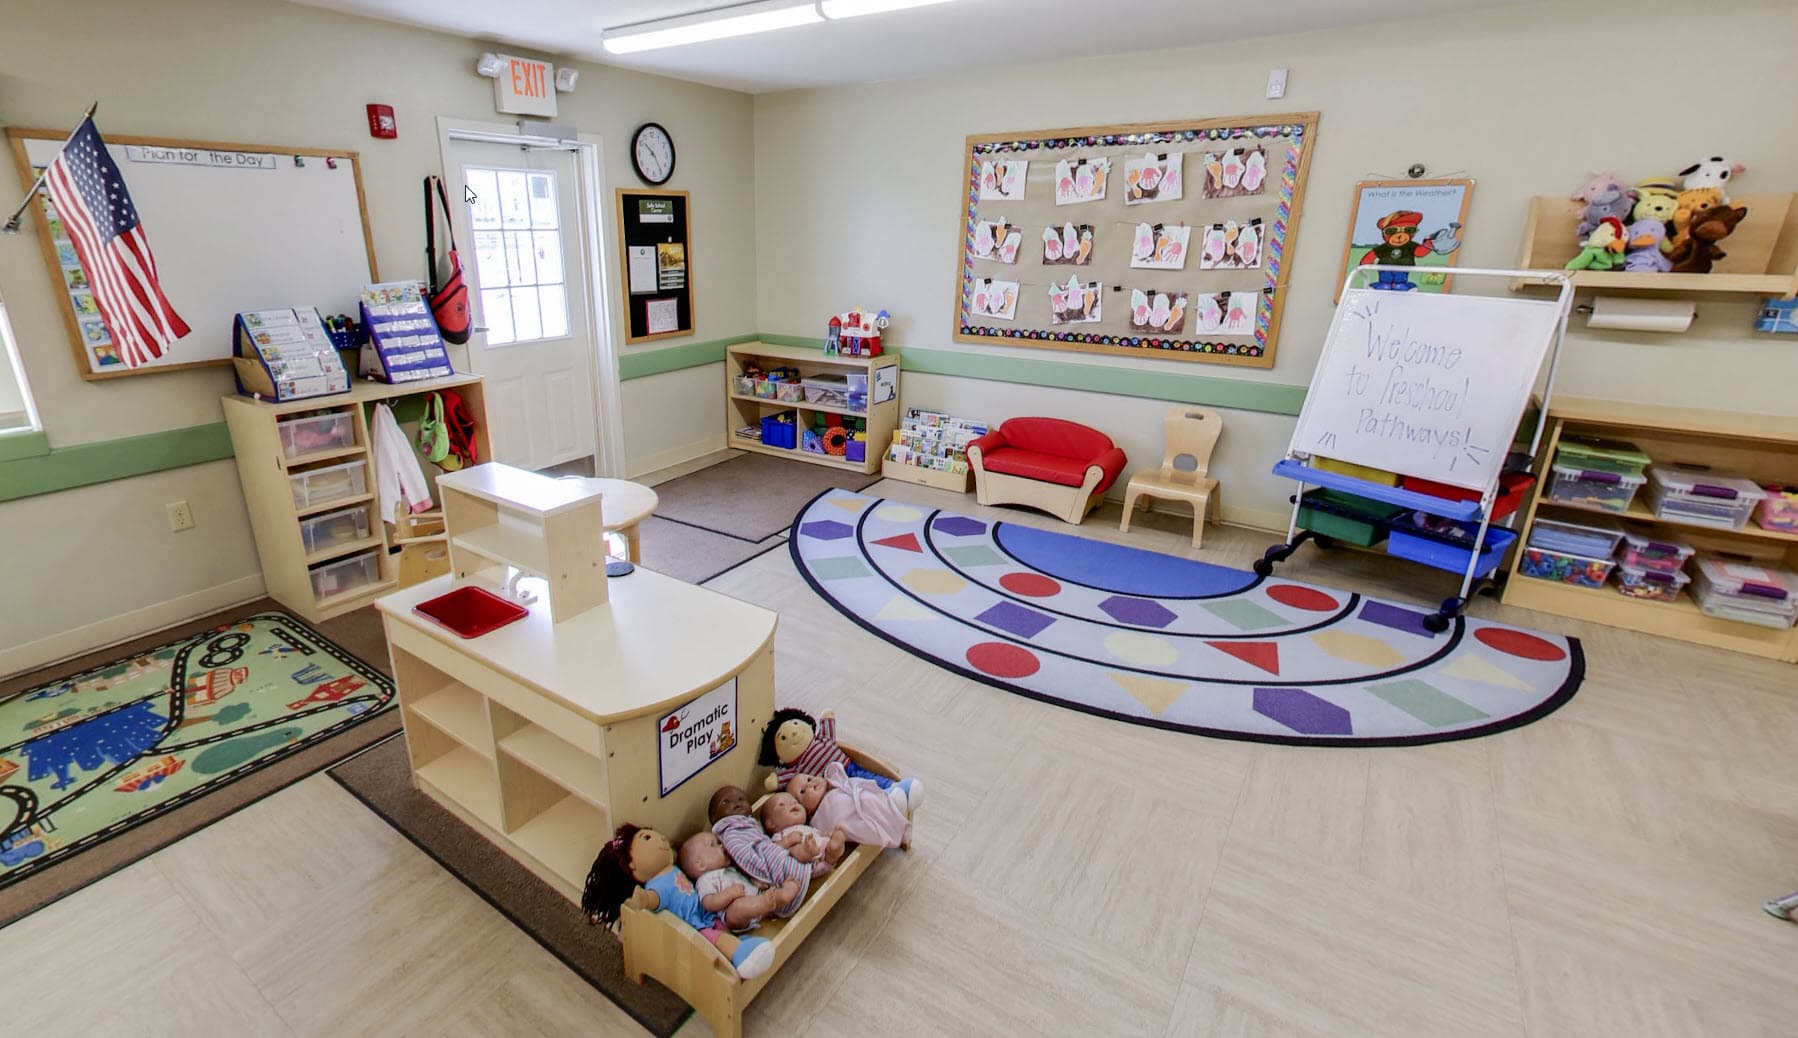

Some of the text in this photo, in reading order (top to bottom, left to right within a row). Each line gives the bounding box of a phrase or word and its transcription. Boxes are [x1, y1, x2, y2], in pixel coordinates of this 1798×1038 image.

[511, 60, 546, 98] EXIT
[142, 148, 264, 167] Plan for the Day
[1368, 190, 1390, 198] What
[1399, 189, 1414, 198] the
[1367, 321, 1463, 370] Welcome
[1346, 364, 1470, 420] to Preschool
[1355, 407, 1471, 460] Pathways!
[670, 704, 729, 749] Dramatic
[687, 728, 714, 754] Play
